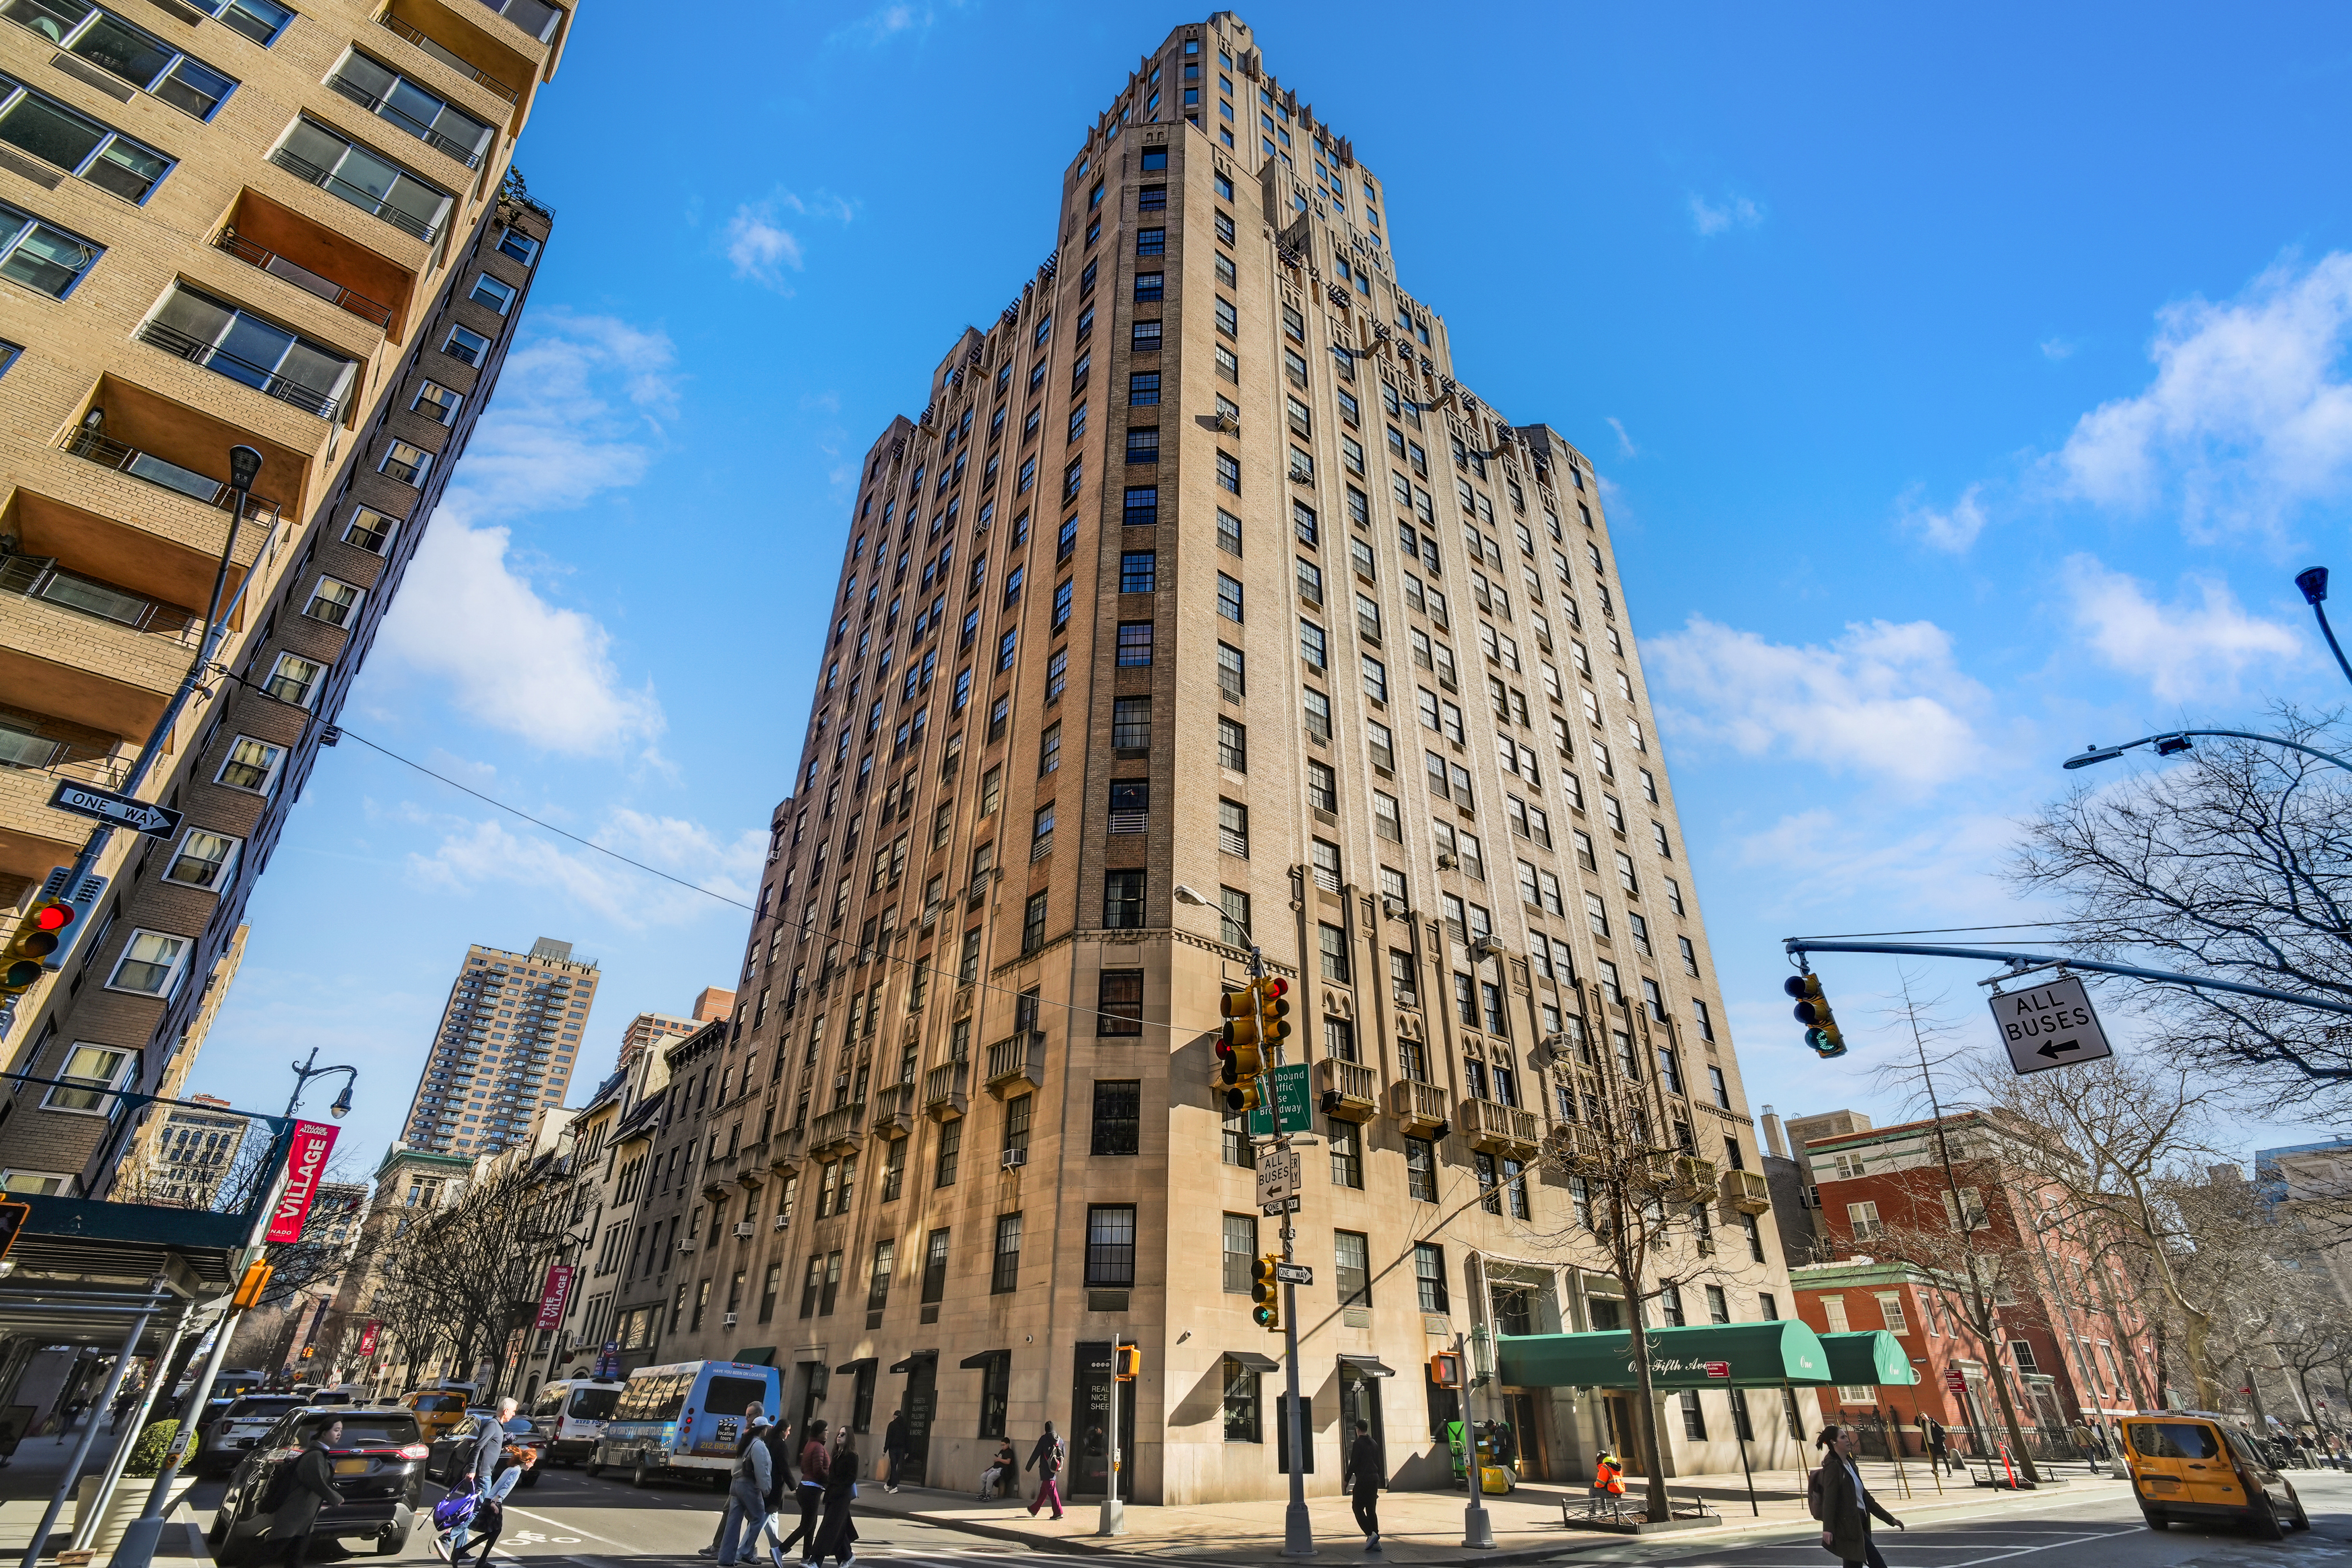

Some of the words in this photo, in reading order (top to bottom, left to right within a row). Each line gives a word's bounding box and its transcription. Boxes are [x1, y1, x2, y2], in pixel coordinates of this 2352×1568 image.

[72, 793, 110, 812] ONE
[124, 807, 162, 826] WAY
[2017, 990, 2065, 1015] ALL
[2005, 1007, 2089, 1041] BUSES
[1266, 1083, 1293, 1093] Taffic
[1260, 1104, 1301, 1116] Brodway
[299, 1128, 328, 1136] ALLIANCE
[304, 1124, 327, 1132] VILLAGE
[1265, 1155, 1283, 1170] ALL
[279, 1139, 327, 1219] VILLAGE
[1259, 1166, 1289, 1186] BUSES
[1269, 1203, 1279, 1211] ONE
[1280, 1269, 1290, 1277] ONE
[1295, 1271, 1308, 1279] WAY
[549, 1275, 568, 1318] VILLAGE
[541, 1297, 555, 1318] THE
[363, 1338, 371, 1349] THE
[367, 1325, 379, 1349] VILLAGE
[1652, 1359, 1683, 1376] Fifth
[1800, 1356, 1813, 1368] One
[1890, 1363, 1900, 1375] One
[637, 1426, 650, 1436] MOVIE
[649, 1426, 663, 1436] TOURS
